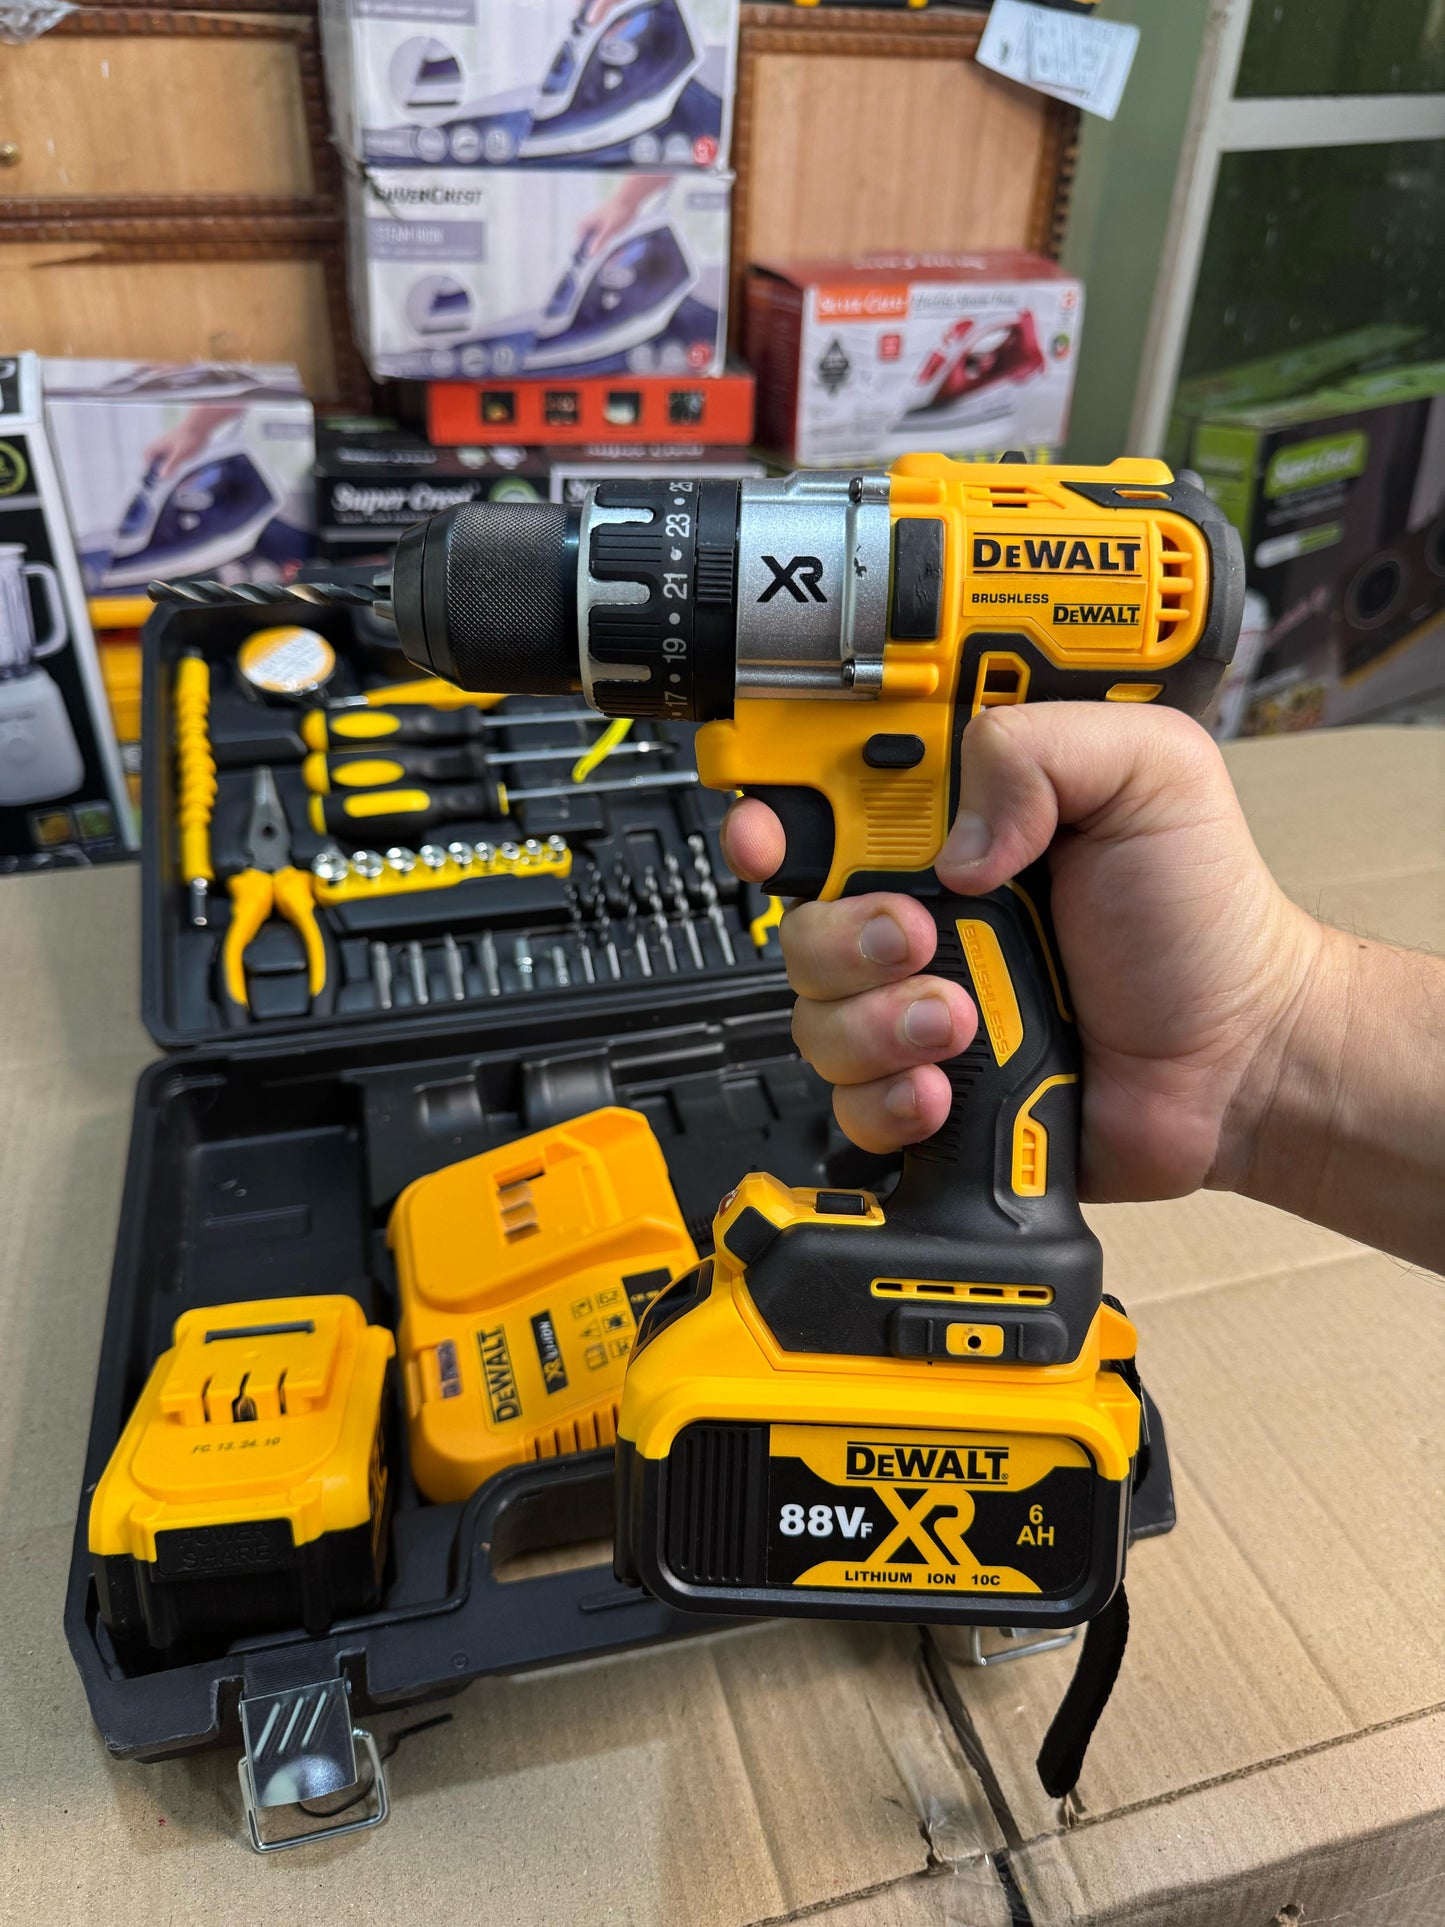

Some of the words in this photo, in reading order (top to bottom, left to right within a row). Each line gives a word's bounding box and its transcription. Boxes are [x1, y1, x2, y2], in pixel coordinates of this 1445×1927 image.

[332, 482, 407, 515] Super
[665, 513, 691, 538] 23
[663, 573, 688, 600] 21
[757, 556, 828, 602] XR
[972, 593, 1049, 603] BRUSHLESS
[662, 638, 687, 663] 19
[664, 691, 688, 707] 17
[962, 924, 1009, 1056] BRUSHLESS
[864, 1485, 982, 1567] XR
[1028, 1504, 1044, 1525] 6
[179, 1522, 270, 1546] POWER
[1016, 1525, 1055, 1547] AH
[182, 1544, 271, 1570] SHARE
[844, 1570, 913, 1584] LITHIUM
[927, 1573, 956, 1585] ION
[971, 1574, 1001, 1586] 10C
